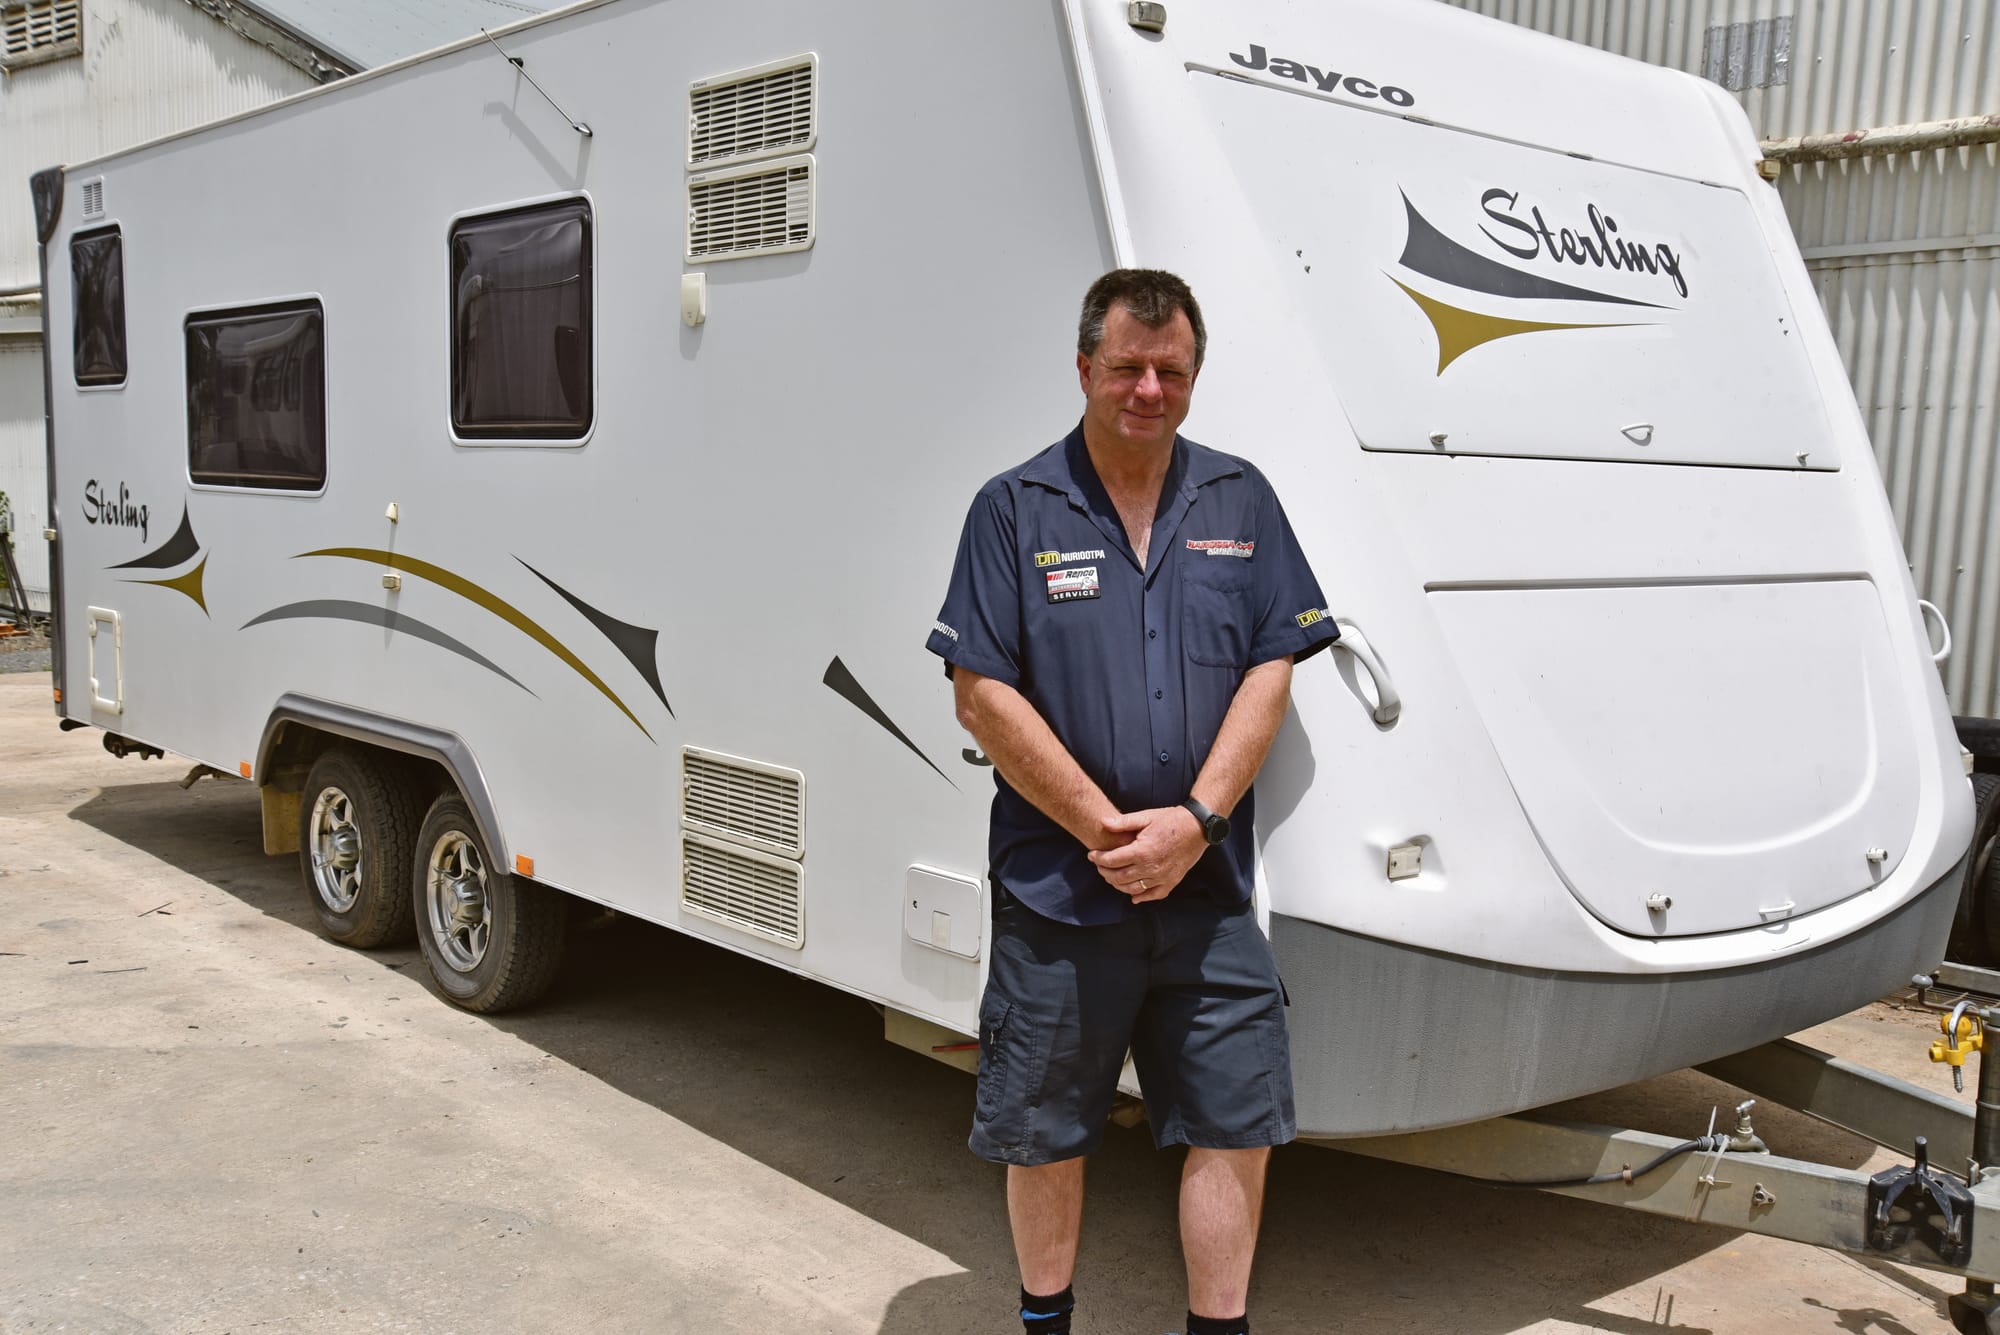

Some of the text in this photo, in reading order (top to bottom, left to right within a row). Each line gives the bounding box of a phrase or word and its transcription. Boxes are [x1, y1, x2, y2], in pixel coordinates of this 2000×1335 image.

[1229, 43, 1415, 107] Jayco
[1477, 188, 1688, 299] Sterling
[81, 478, 150, 544] Sterling
[1053, 589, 1095, 600] SERVICE
[1065, 569, 1095, 580] Repco
